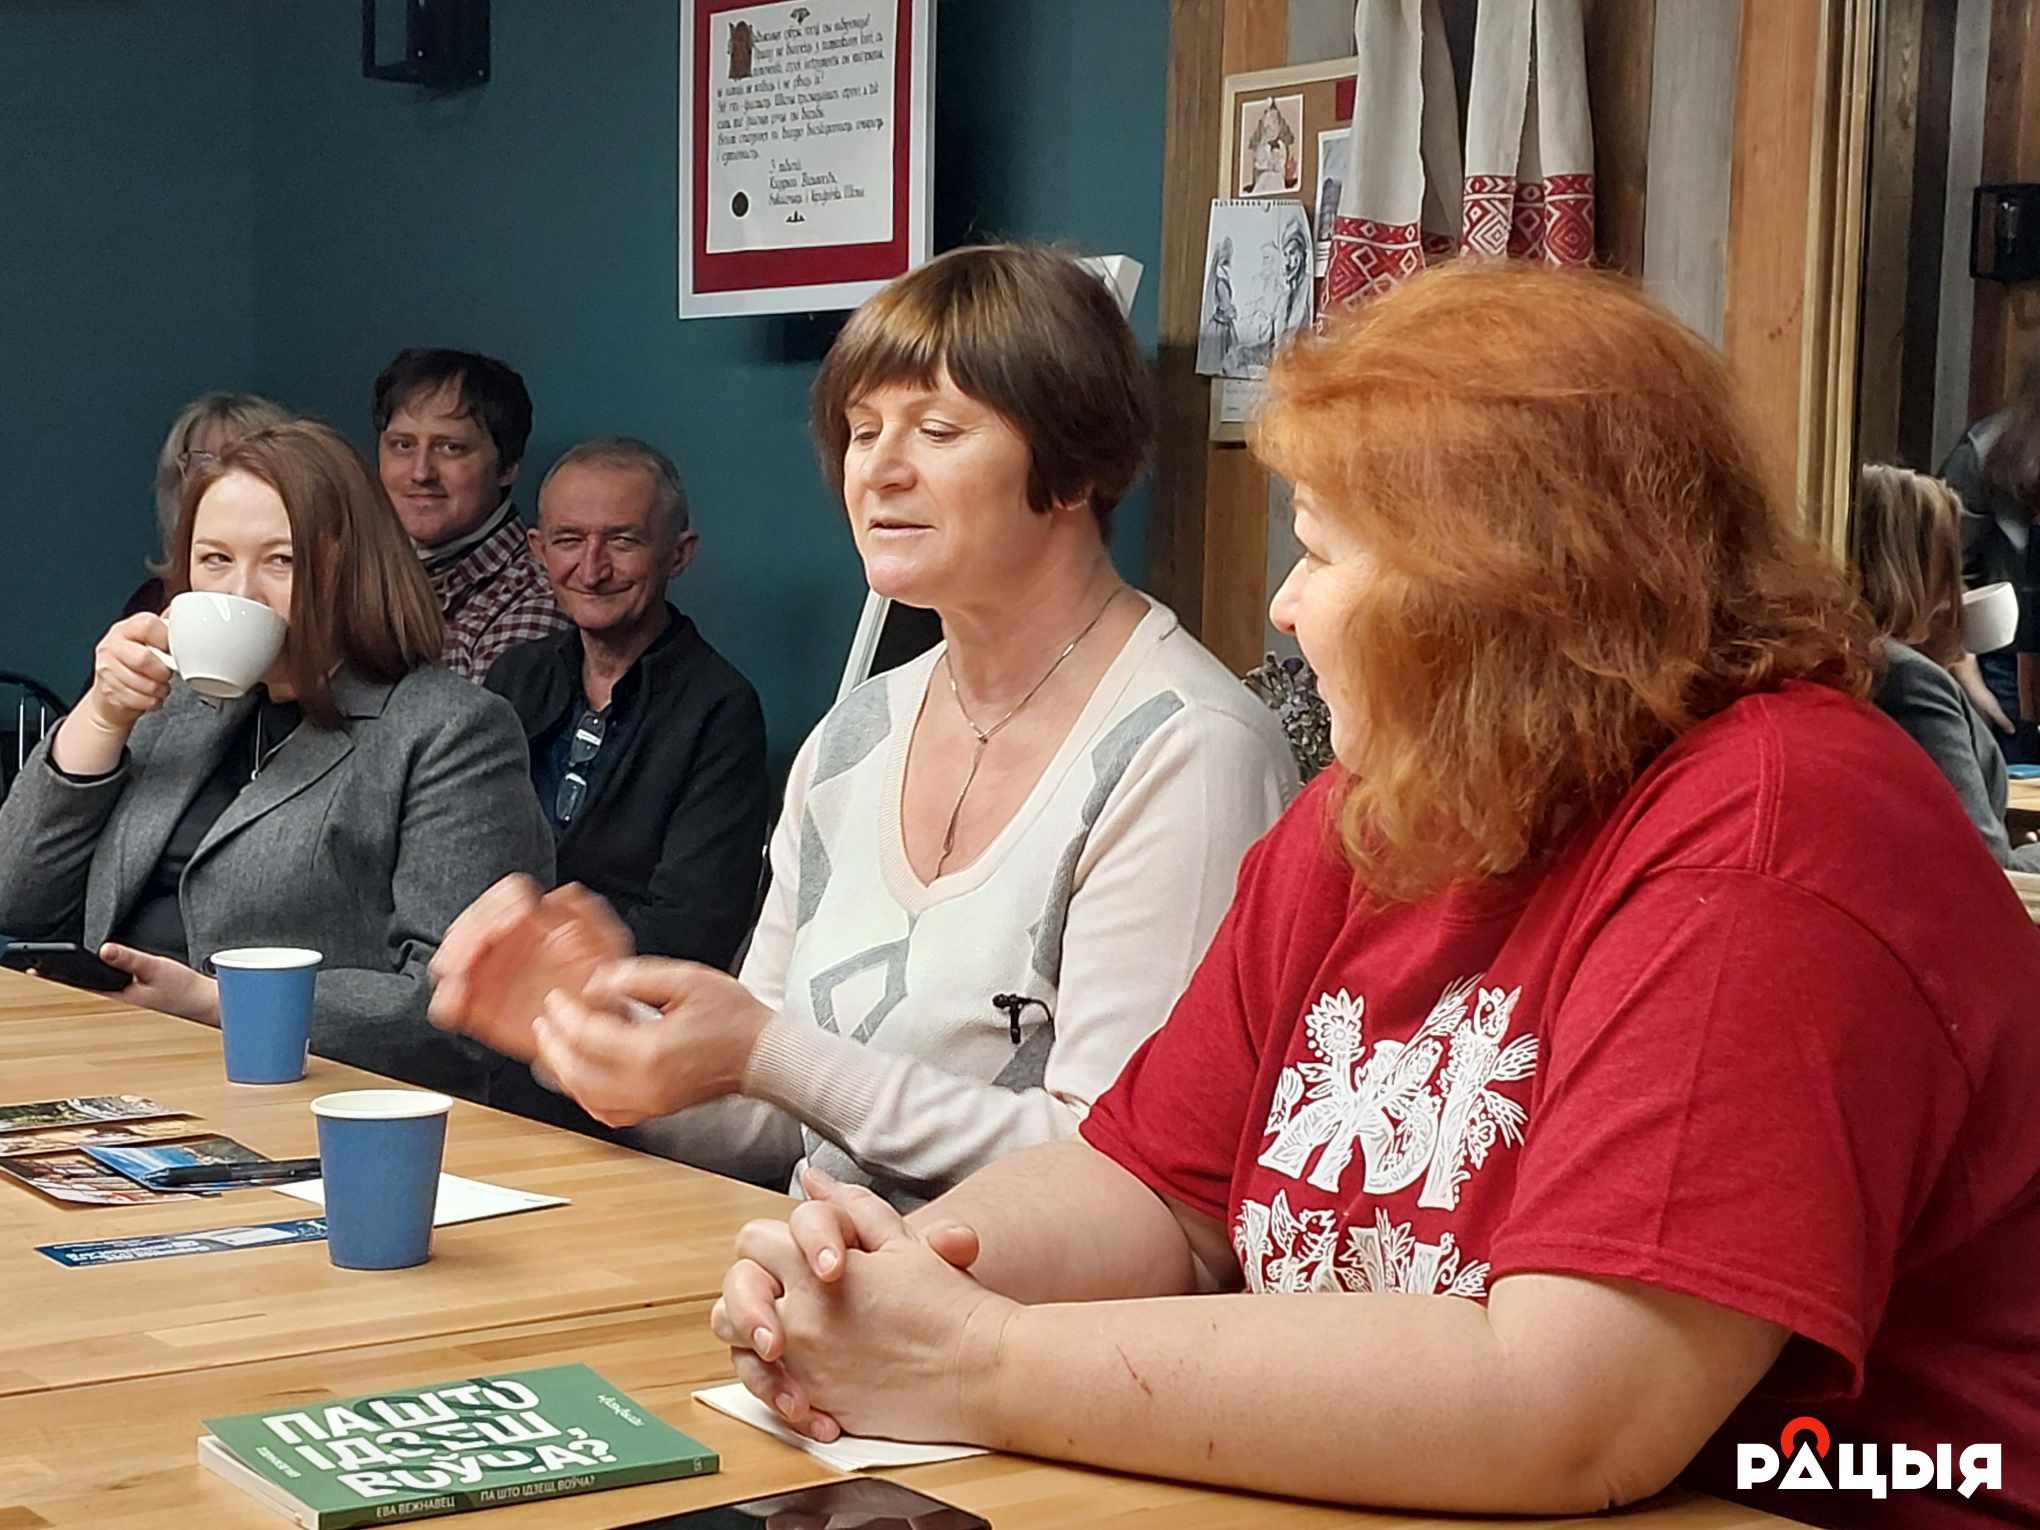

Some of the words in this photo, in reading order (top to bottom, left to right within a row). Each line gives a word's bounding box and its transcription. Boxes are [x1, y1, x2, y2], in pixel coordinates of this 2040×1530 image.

[497, 1486, 521, 1500] ШТО
[376, 1505, 398, 1518] ЕВА
[399, 1496, 456, 1515] ВЕЖНАВЕЦ
